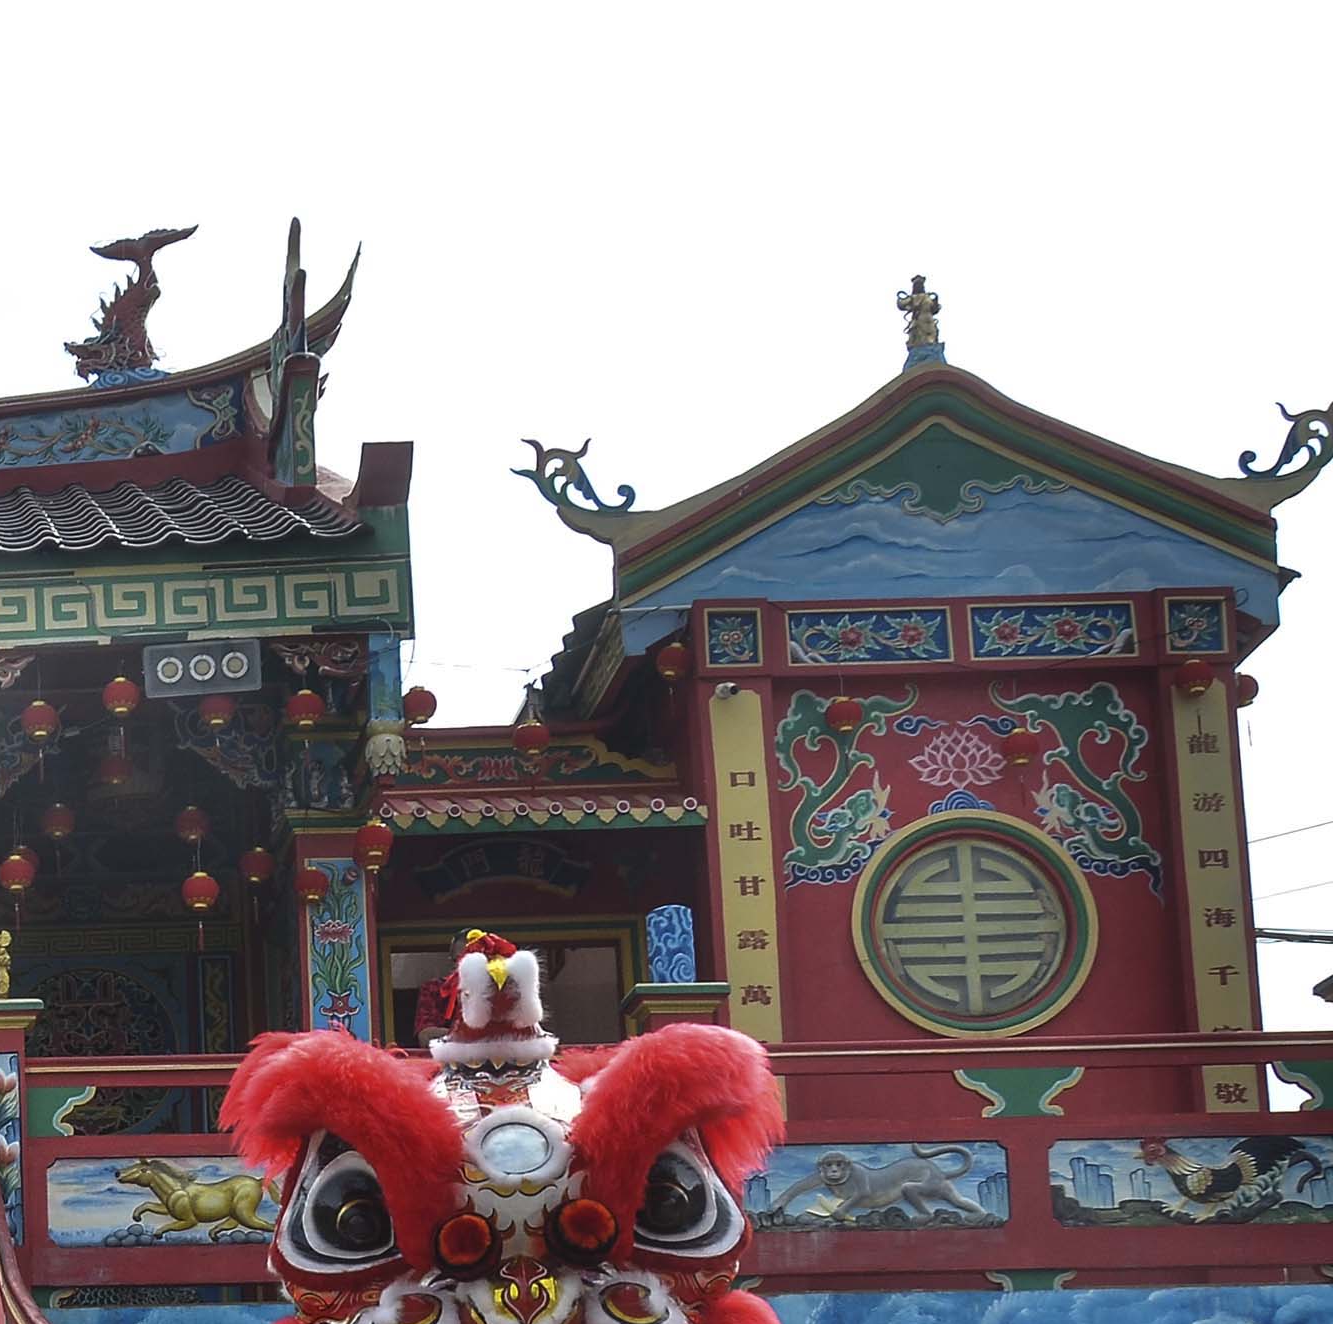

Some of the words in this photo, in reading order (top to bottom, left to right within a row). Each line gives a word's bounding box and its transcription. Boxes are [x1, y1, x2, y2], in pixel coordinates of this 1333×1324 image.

[729, 770, 773, 1043] 口吐甘露萬
[1187, 733, 1248, 1104] 龍游四海千敬
